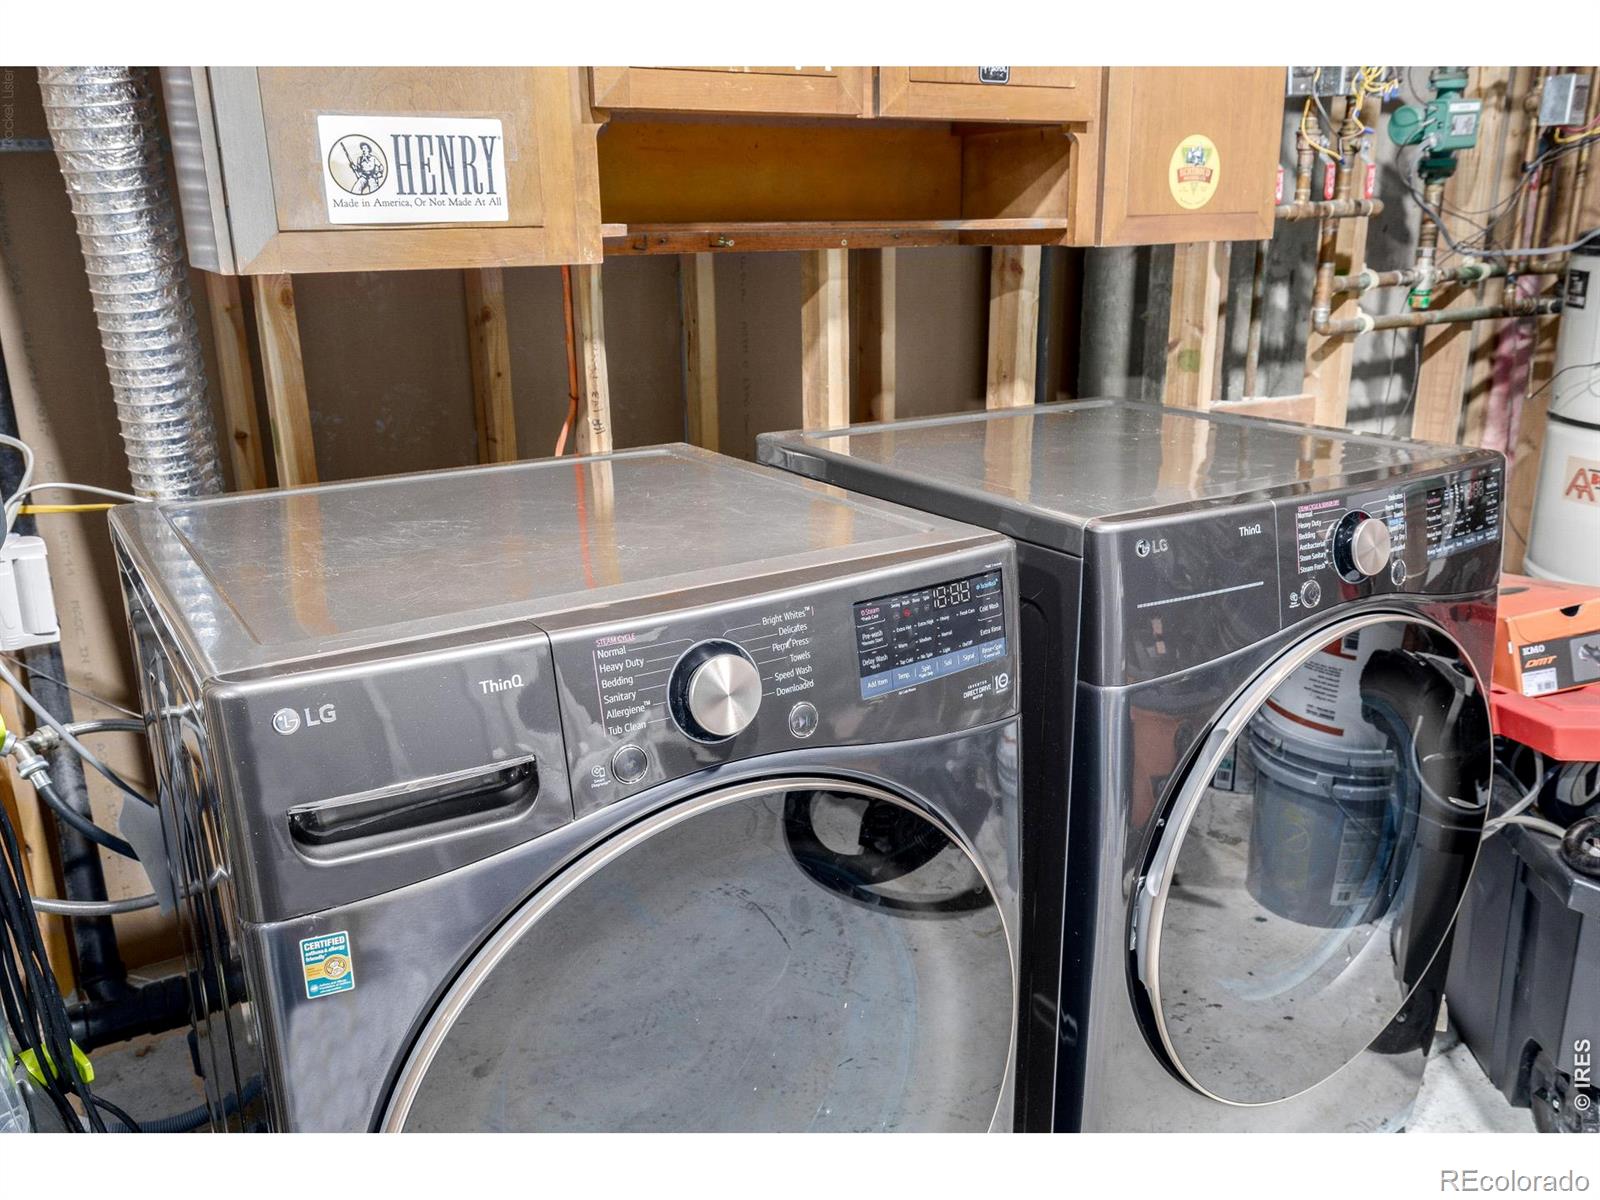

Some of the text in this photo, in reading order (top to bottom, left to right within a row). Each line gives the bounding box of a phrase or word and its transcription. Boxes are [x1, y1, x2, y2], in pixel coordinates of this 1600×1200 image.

[390, 134, 498, 196] HENRY
[333, 197, 502, 208] Made in America, Or Not Made At All
[1239, 524, 1261, 537] ThinQ
[1152, 539, 1168, 553] LG
[762, 614, 783, 626] Bright
[778, 623, 808, 636] Delicates
[596, 633, 636, 646] STEAM CYCLE
[792, 637, 809, 648] Press
[597, 645, 626, 658] Normal
[790, 651, 811, 662] Towels
[599, 658, 644, 673] Heavy Duty
[774, 665, 813, 682] Speed Wash
[479, 674, 524, 695] ThinQ
[601, 676, 633, 689] Bedding
[776, 679, 814, 697] Downloaded
[979, 684, 992, 694] DRIVE
[603, 691, 636, 704] Sanitary
[304, 704, 337, 727] LG
[608, 721, 647, 736] Tub Clean
[304, 936, 345, 951] CERTIFIED
